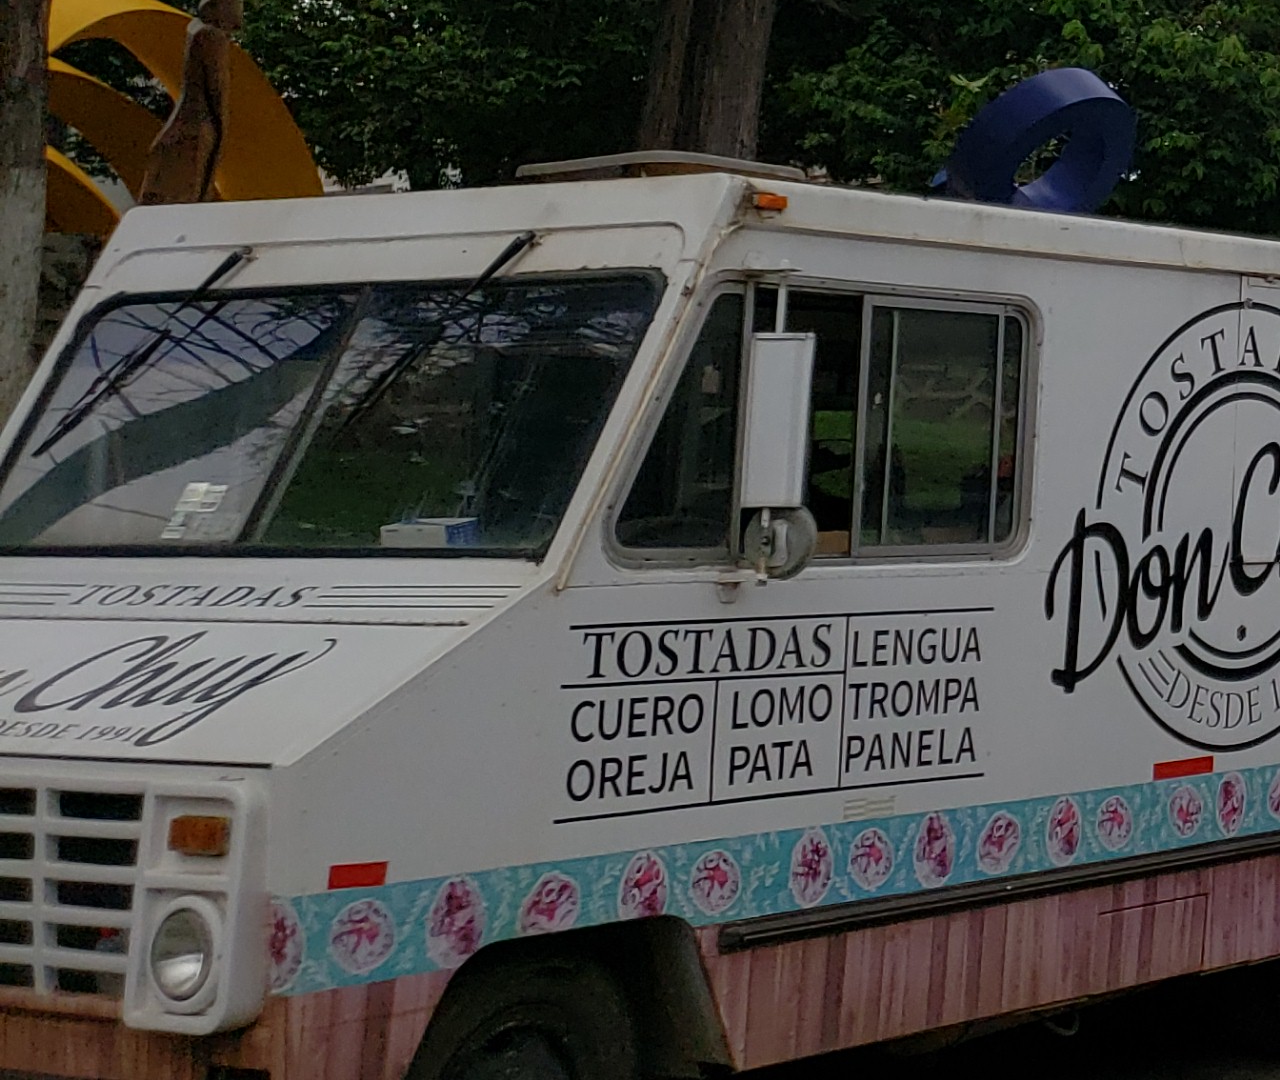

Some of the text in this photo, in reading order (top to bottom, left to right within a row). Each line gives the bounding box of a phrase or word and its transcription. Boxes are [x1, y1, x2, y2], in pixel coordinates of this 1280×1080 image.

[70, 584, 320, 608] TOSTADAS
[1044, 507, 1230, 694] Don
[583, 622, 832, 679] TOSTADAS
[851, 626, 982, 668] LENGUA
[13, 630, 338, 747] Chuy
[730, 684, 833, 731] LOMO
[848, 676, 980, 720] TROMPA
[1164, 664, 1262, 729] DESDE
[74, 724, 147, 743] 1991
[570, 693, 704, 743] CUERO
[728, 739, 814, 786] PATA
[844, 727, 977, 774] PANELA
[566, 751, 695, 802] OREJA
